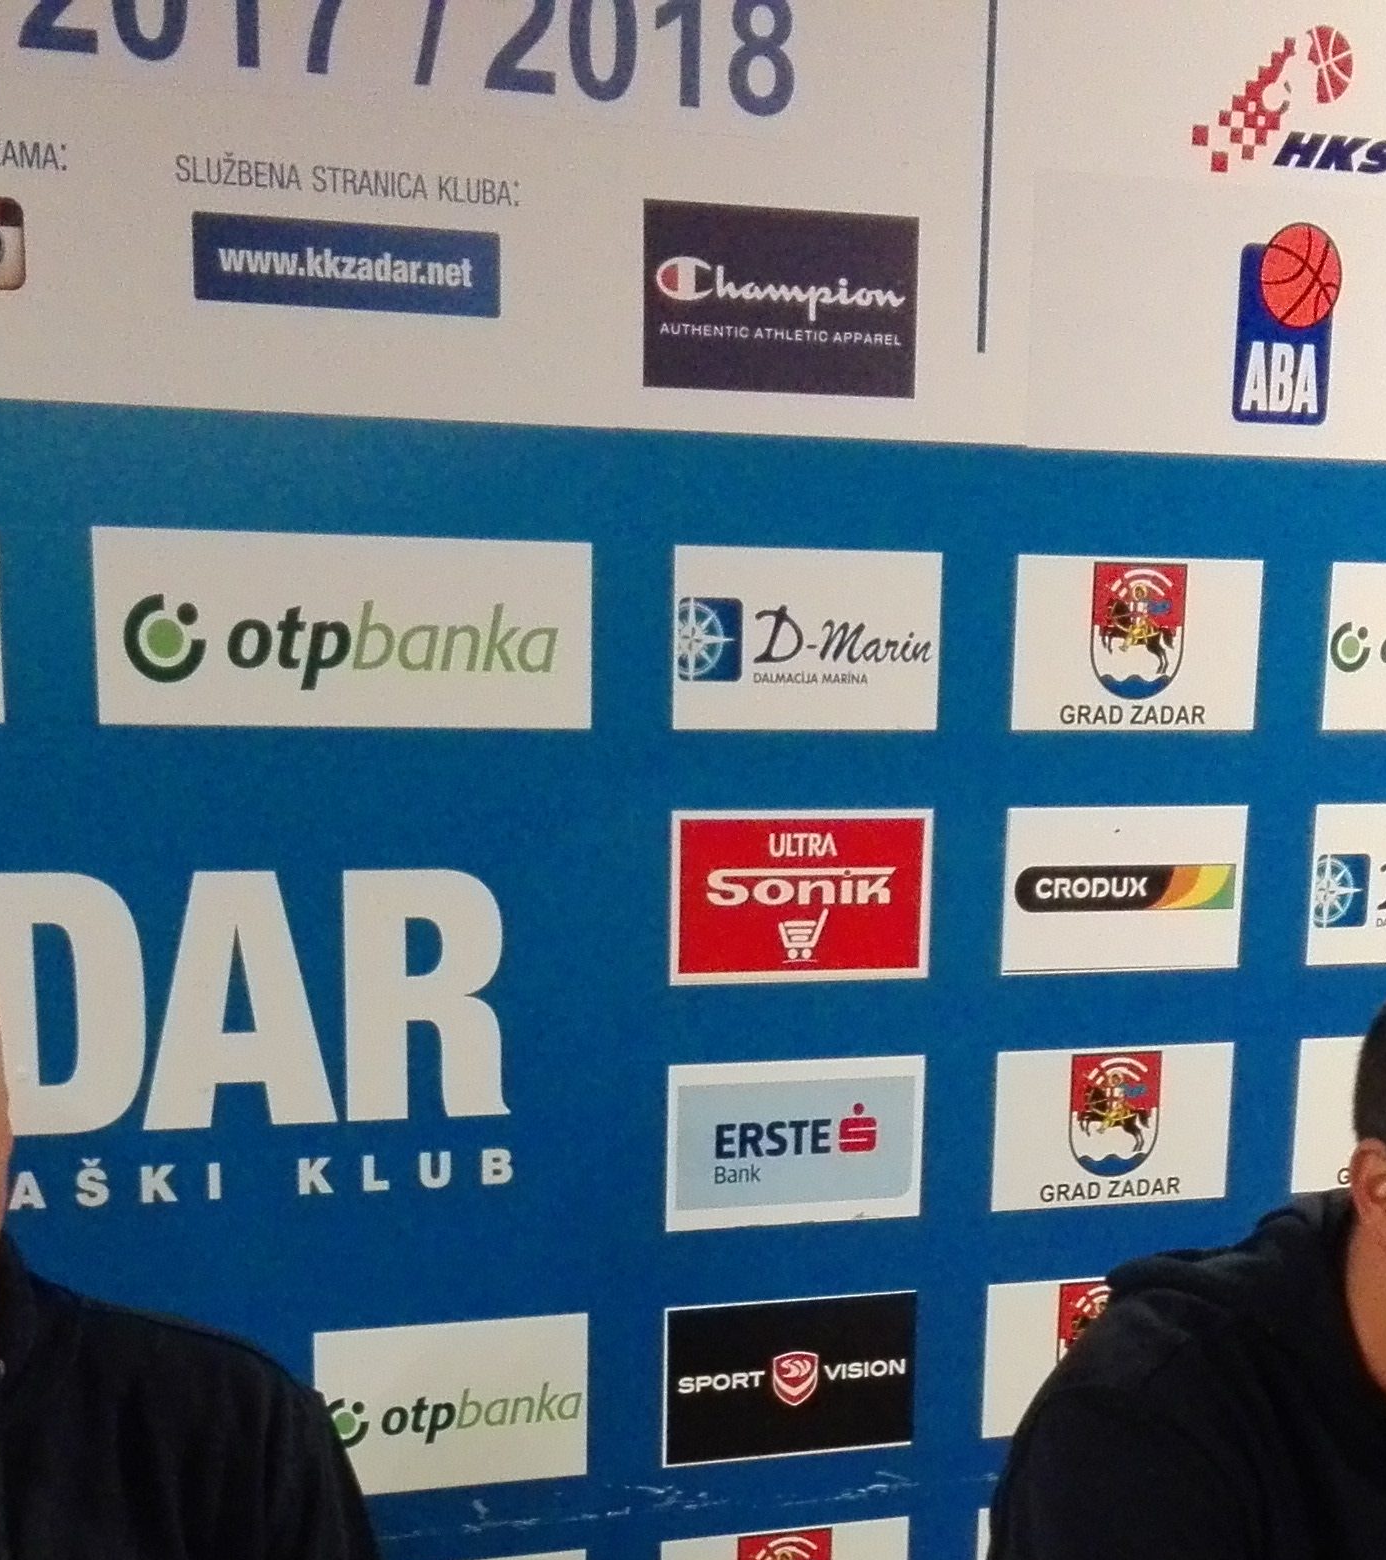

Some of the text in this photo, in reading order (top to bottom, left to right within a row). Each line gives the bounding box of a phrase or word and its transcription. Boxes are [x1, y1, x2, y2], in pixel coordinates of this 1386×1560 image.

[484, 0, 795, 117] 2018
[175, 153, 520, 208] SLUŽBENA STRANICA KLUBA:
[218, 243, 474, 291] www.kkzadar.net
[655, 256, 907, 319] Champion
[659, 321, 902, 346] AUTHENTIC ATHLETIC APPAREL
[1241, 342, 1317, 415] ABA
[227, 604, 558, 691] otpbanka
[753, 604, 933, 664] D-Marin
[1060, 704, 1206, 727] GRAD ZADAR
[768, 832, 838, 857] ULTRA
[1035, 876, 1149, 899] CRODUX
[714, 1118, 832, 1160] ERSTE
[298, 1148, 514, 1196] KLUB
[714, 1165, 761, 1186] Bank
[1040, 1176, 1181, 1203] GRAD ZADAR
[678, 1357, 907, 1394] SPORT VISION
[381, 1382, 582, 1444] otpbanka
